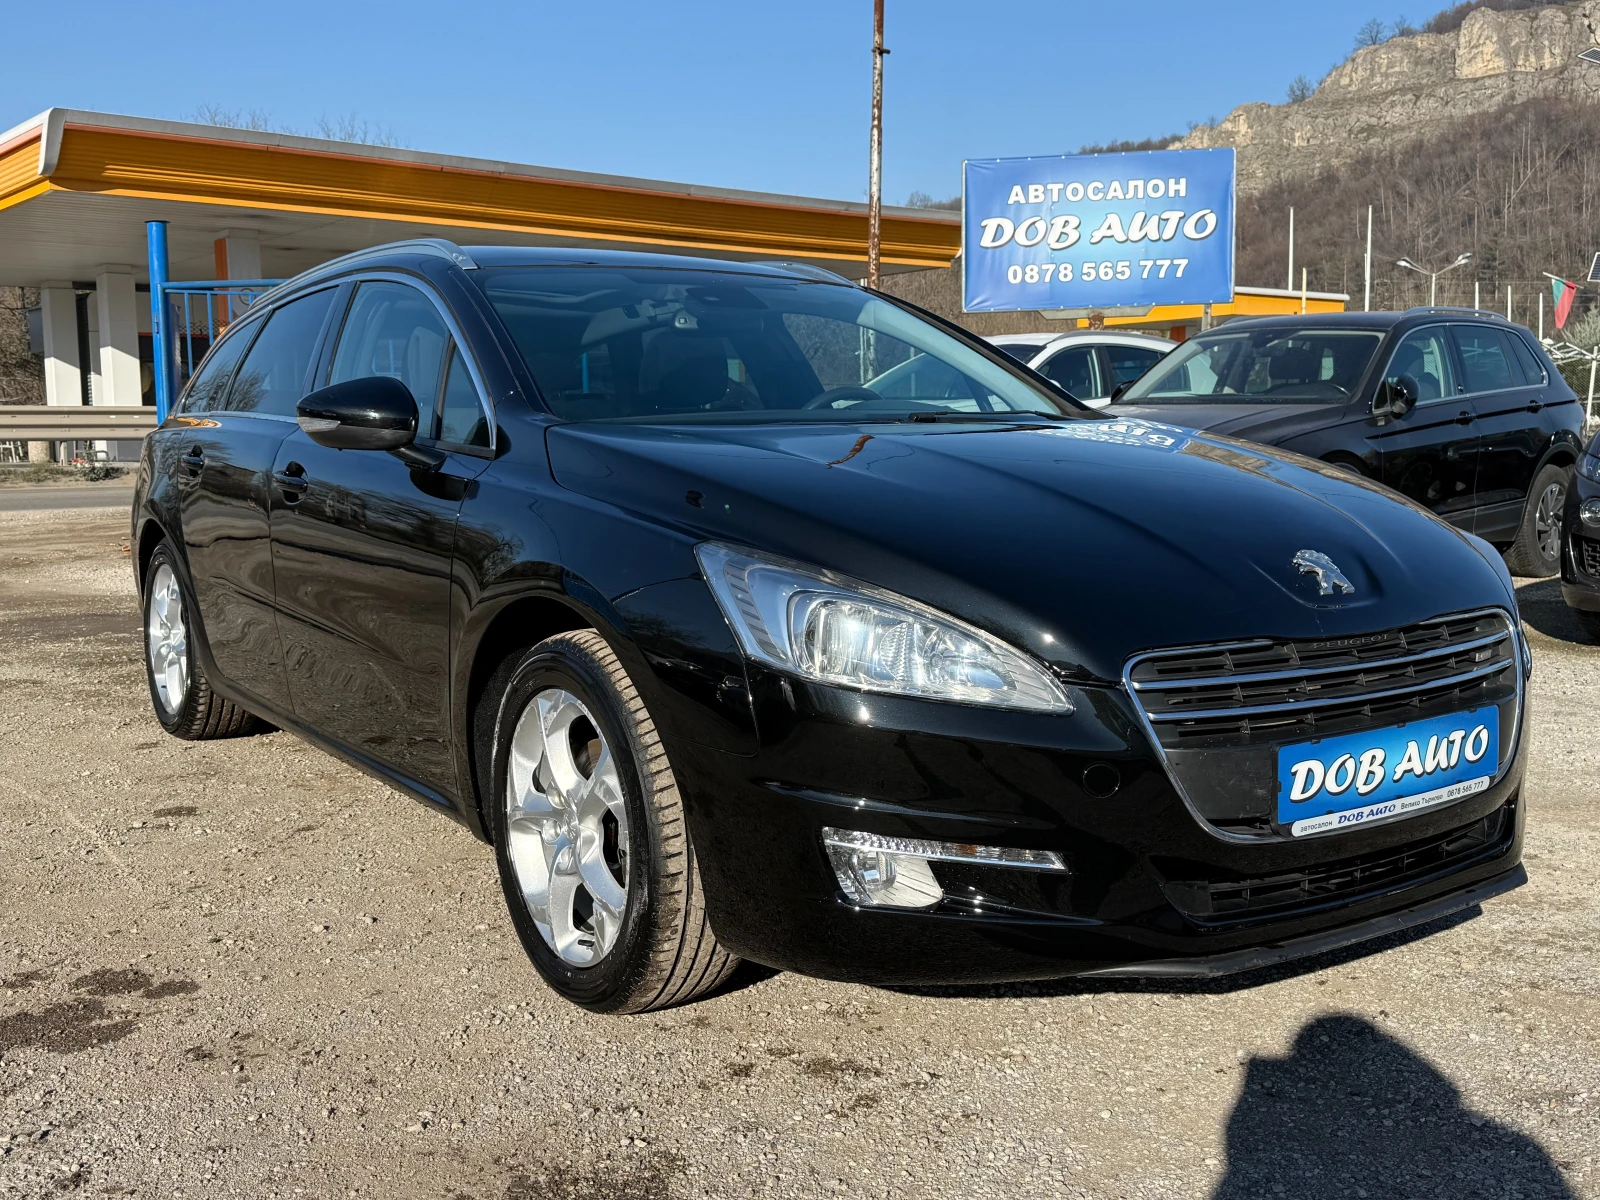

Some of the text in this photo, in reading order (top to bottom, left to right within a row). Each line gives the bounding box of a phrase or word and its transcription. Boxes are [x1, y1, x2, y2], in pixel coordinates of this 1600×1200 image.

[1007, 177, 1187, 205] АВТОСАЛОН
[979, 209, 1217, 250] DOB AUTO
[1007, 258, 1189, 285] 0878 565 777
[1313, 634, 1388, 649] PEUGEOT
[1289, 724, 1490, 803] DOB AUTO
[1300, 820, 1333, 833] автосалон
[1337, 811, 1364, 825] DOB
[1365, 803, 1397, 819] AUTO
[1446, 787, 1461, 798] 0878
[1462, 784, 1472, 794] 565
[1473, 780, 1484, 791] 777
